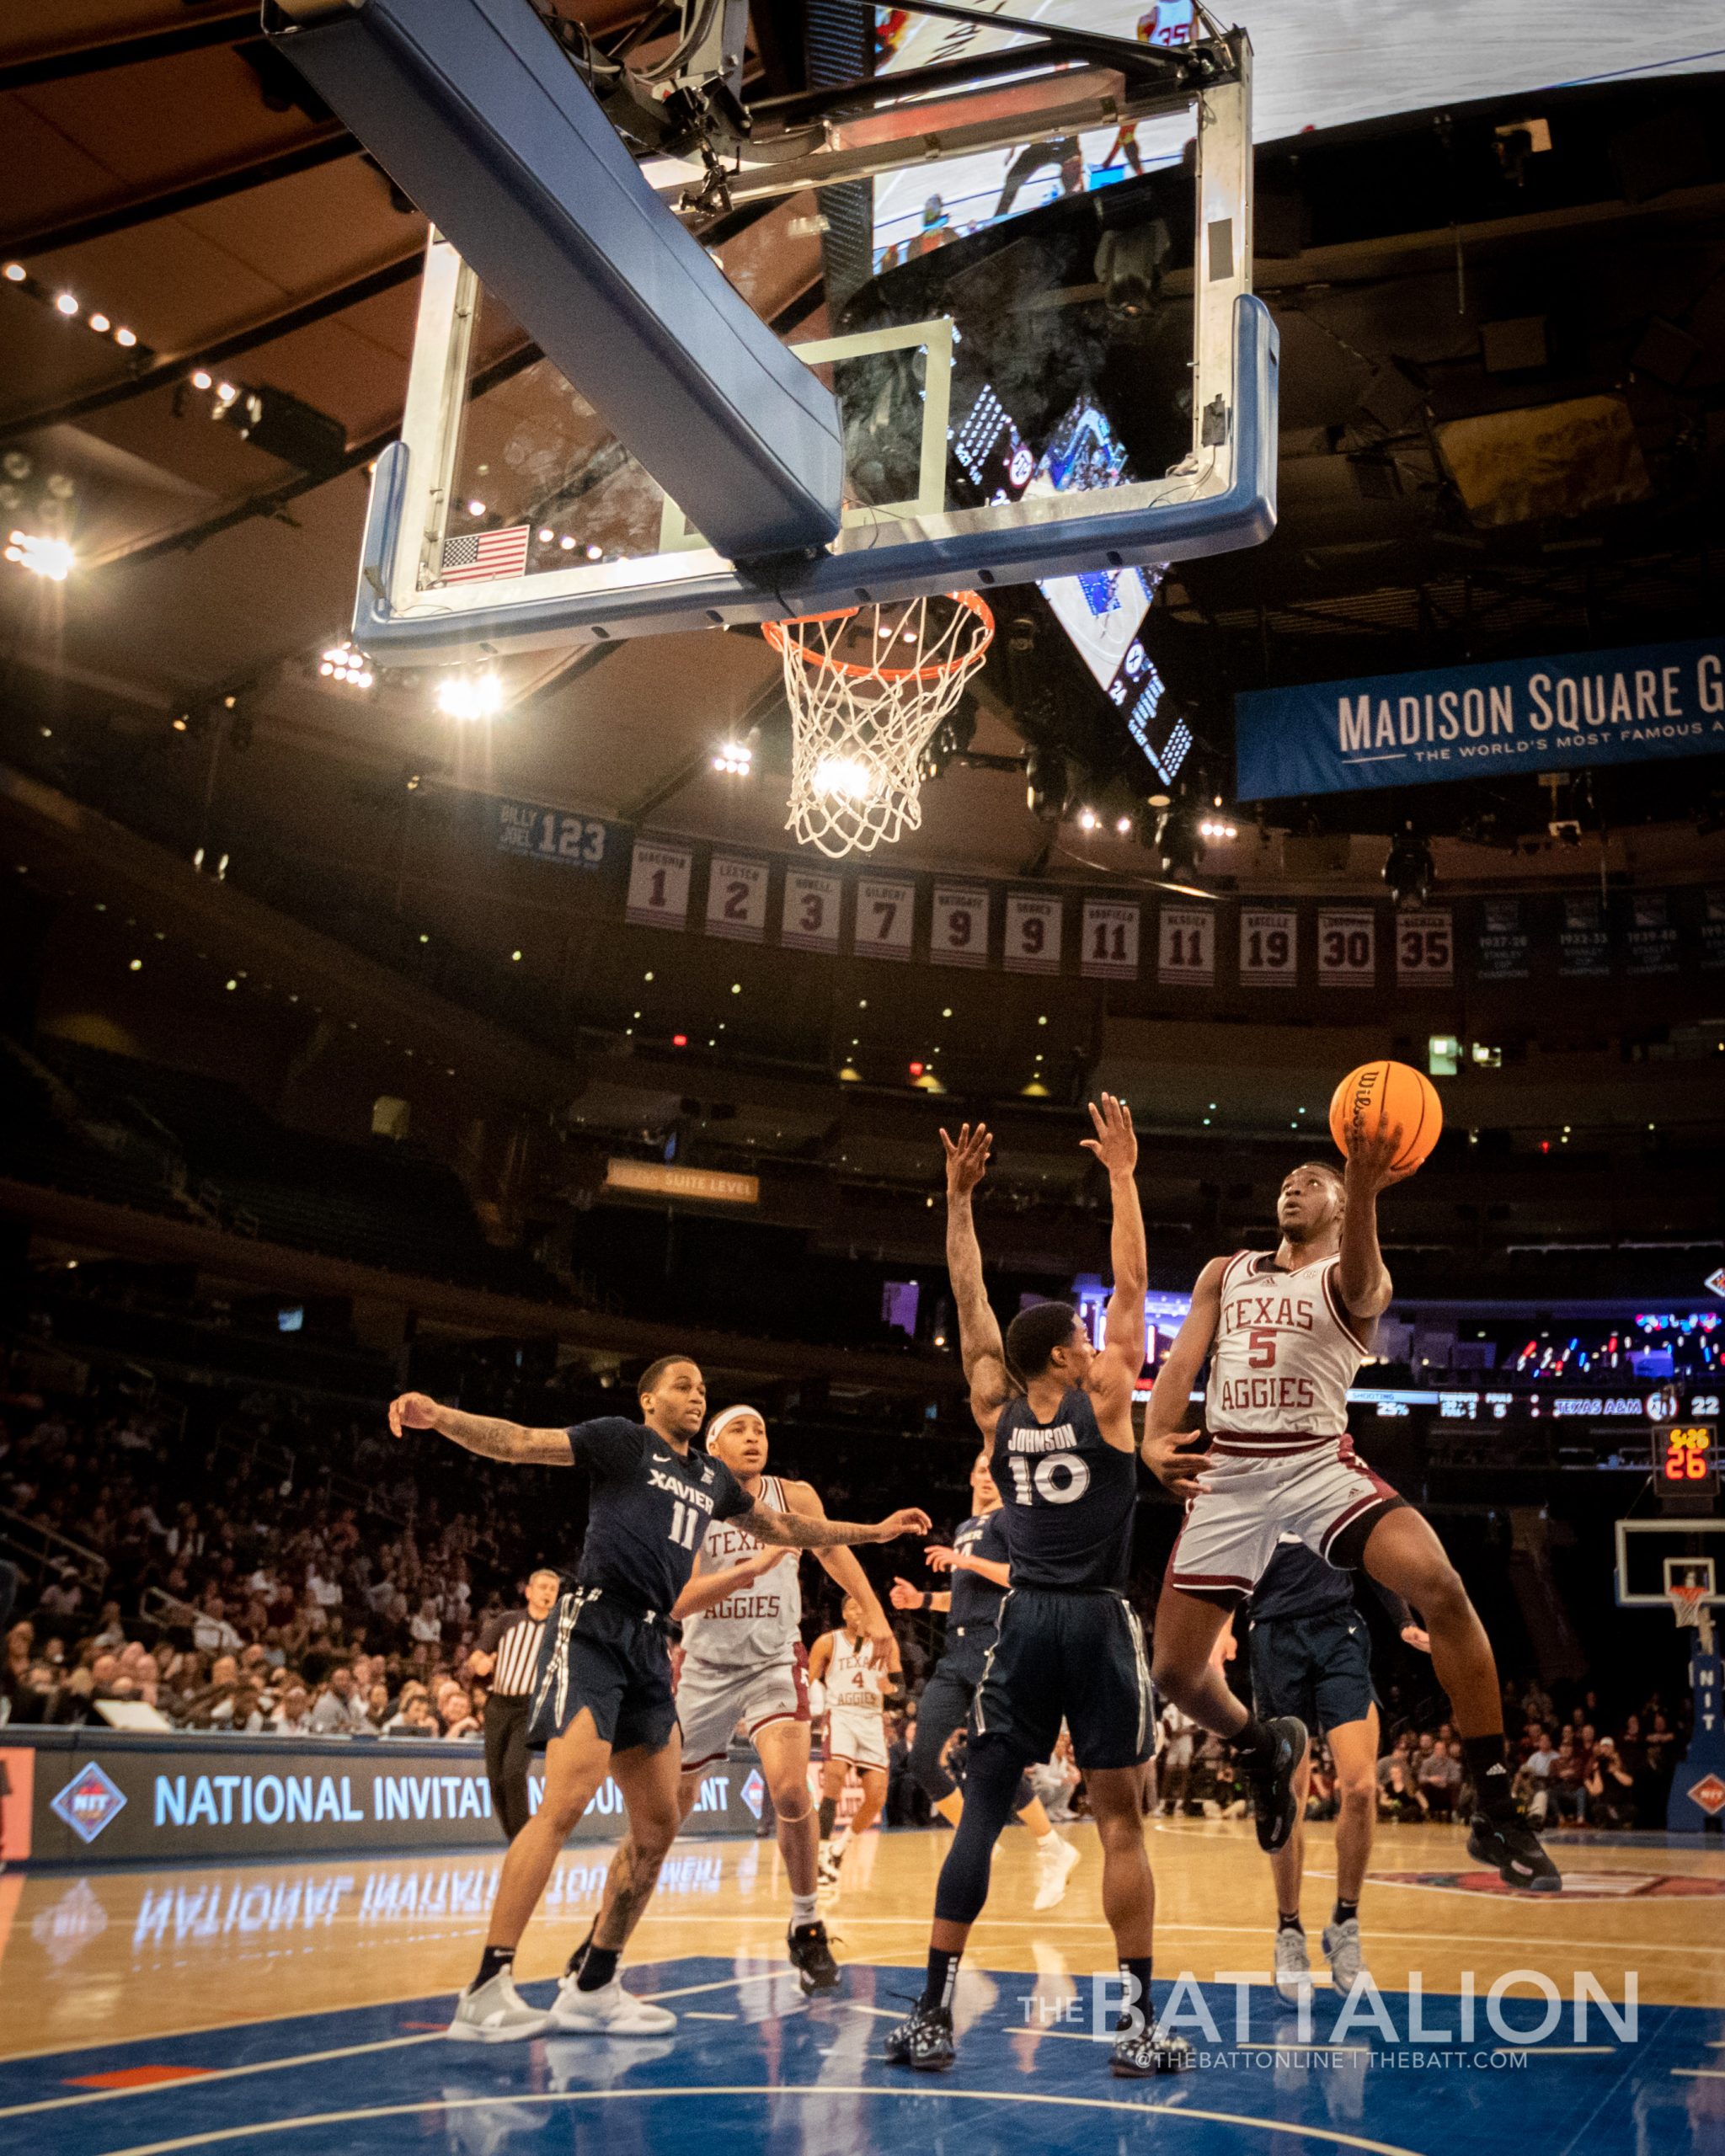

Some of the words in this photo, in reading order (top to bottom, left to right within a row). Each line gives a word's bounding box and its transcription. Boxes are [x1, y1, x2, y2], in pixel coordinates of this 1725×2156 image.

[1338, 685, 1514, 752] MADISON
[1528, 665, 1683, 733] SQUARE
[1414, 748, 1451, 762] THE
[1459, 738, 1548, 758] WORLD'S
[1557, 731, 1610, 748] MOST
[1620, 721, 1703, 742] FAMOUS
[538, 813, 606, 862] 123
[648, 868, 666, 908] 1
[724, 882, 750, 921] 2
[799, 893, 823, 931] 3
[873, 902, 897, 940] 7
[948, 910, 971, 947] 9
[1021, 917, 1045, 954] 9
[1092, 923, 1126, 961] 11
[1168, 929, 1204, 967] 11
[1247, 931, 1289, 968] 19
[1322, 931, 1370, 968] 30
[1400, 931, 1450, 968] 35
[710, 1179, 752, 1195] LEVEL
[1224, 1297, 1313, 1334] TEXAS
[1248, 1328, 1277, 1369] 5
[1221, 1378, 1314, 1411] AGGIES
[1352, 1392, 1395, 1401] SHOOTING
[1554, 1398, 1602, 1416] TEXAS
[1603, 1398, 1642, 1416] A&M
[1691, 1396, 1720, 1416] 22
[1007, 1423, 1078, 1454] JOHNSON
[1007, 1453, 1091, 1506] 10
[1665, 1447, 1707, 1480] 26
[647, 1468, 715, 1516] XAVIER
[667, 1500, 699, 1550] 11
[702, 1596, 781, 1619] AGGIES
[838, 1691, 877, 1706] AGGIES
[851, 1671, 864, 1689] 4
[72, 1792, 109, 1812] NIT
[154, 1774, 364, 1826] NATIONAL
